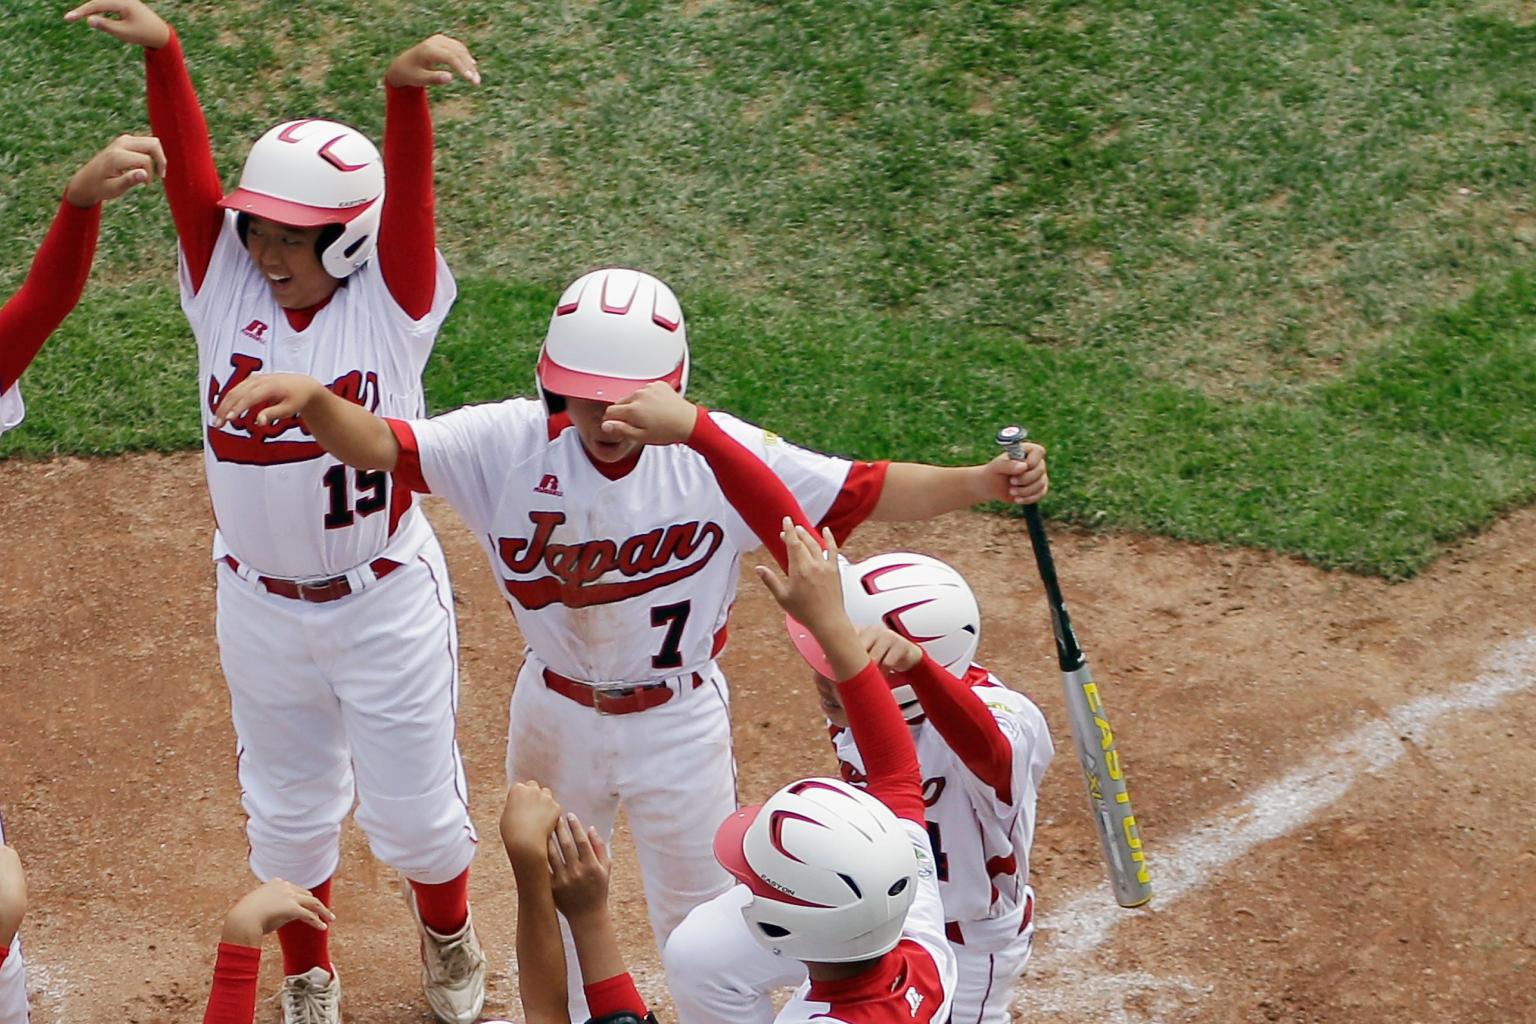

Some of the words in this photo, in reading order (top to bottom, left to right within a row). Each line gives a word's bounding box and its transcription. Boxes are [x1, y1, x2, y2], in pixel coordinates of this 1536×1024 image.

[323, 464, 386, 529] 15
[498, 511, 723, 586] Japan
[651, 599, 691, 669] 7
